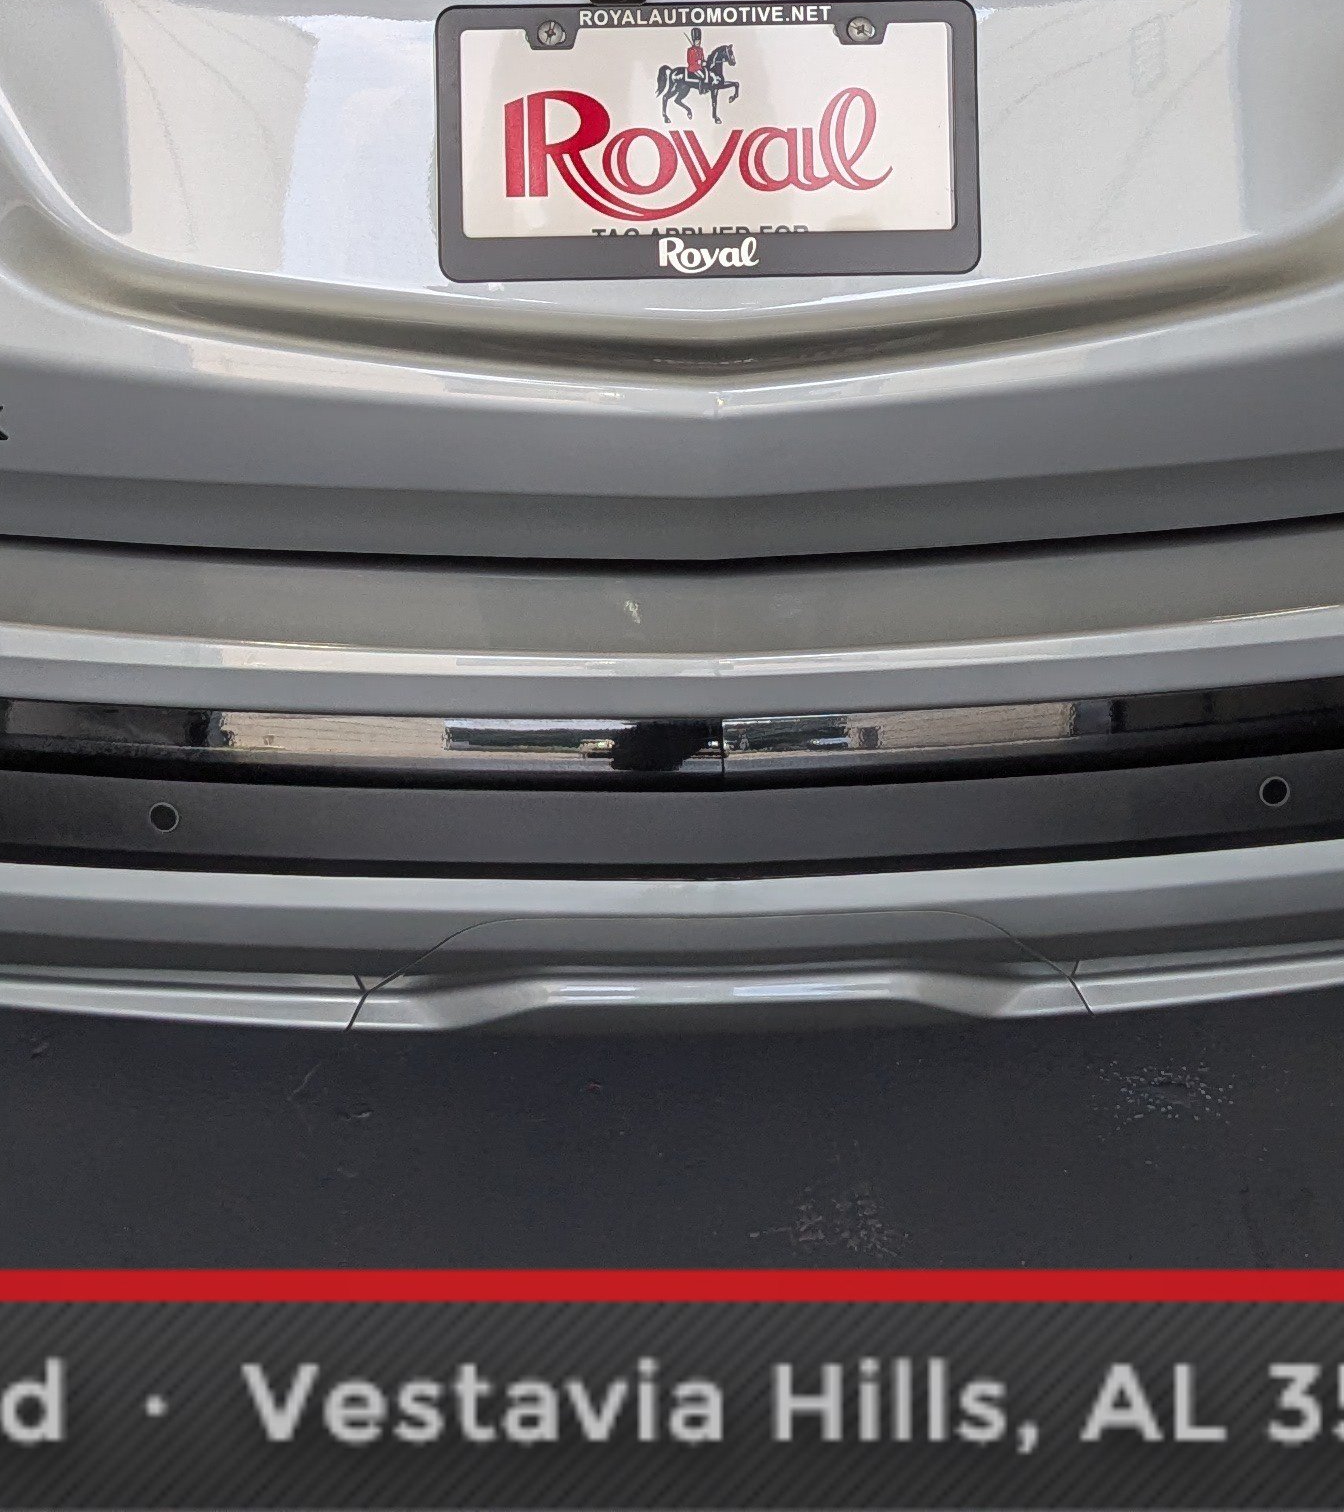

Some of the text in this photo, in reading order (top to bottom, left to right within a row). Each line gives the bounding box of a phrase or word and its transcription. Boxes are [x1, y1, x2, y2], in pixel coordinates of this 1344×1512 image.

[578, 5, 833, 27] ROYALAUTOMOTIVE.NET
[503, 87, 894, 222] Royal
[658, 236, 760, 274] Royal
